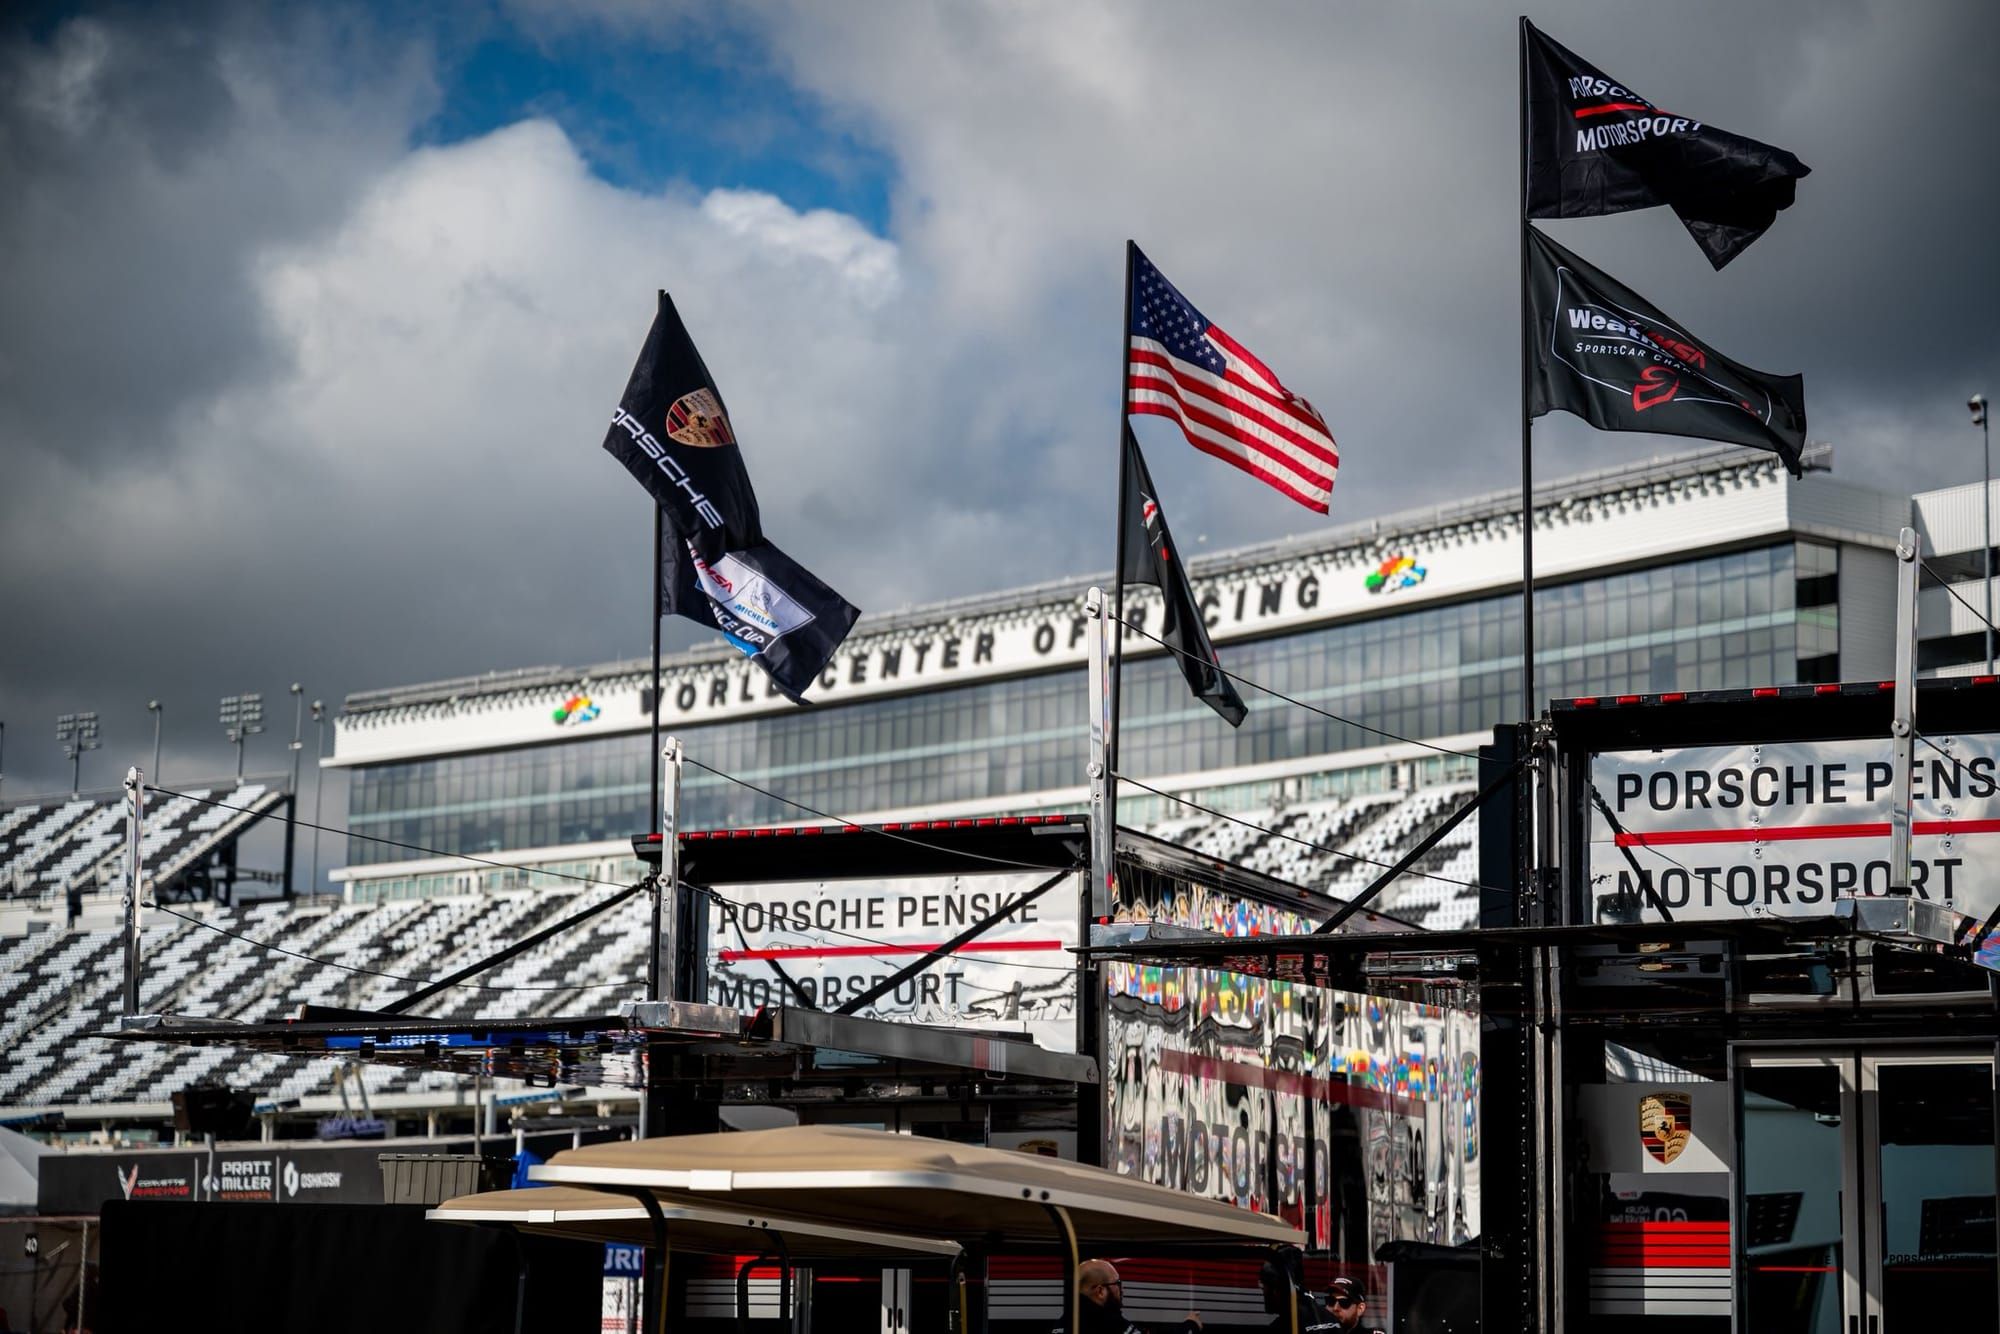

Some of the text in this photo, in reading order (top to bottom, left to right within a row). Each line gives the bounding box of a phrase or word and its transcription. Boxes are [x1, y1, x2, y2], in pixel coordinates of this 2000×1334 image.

[734, 604, 779, 629] MICHELIN
[818, 633, 995, 689] CENTER
[1034, 616, 1089, 655] OF
[1124, 572, 1320, 639] RCING
[734, 626, 765, 644] CUP
[1617, 763, 1847, 813] PORSCHE
[1618, 858, 1963, 909] MOTORSPORT
[717, 892, 1039, 935] PORSCHE PENSKE
[718, 972, 964, 1009] MOTORSPORT
[221, 1176, 272, 1190] MILLER
[222, 1161, 272, 1175] PRATT
[301, 1172, 341, 1188] OSHKOSH
